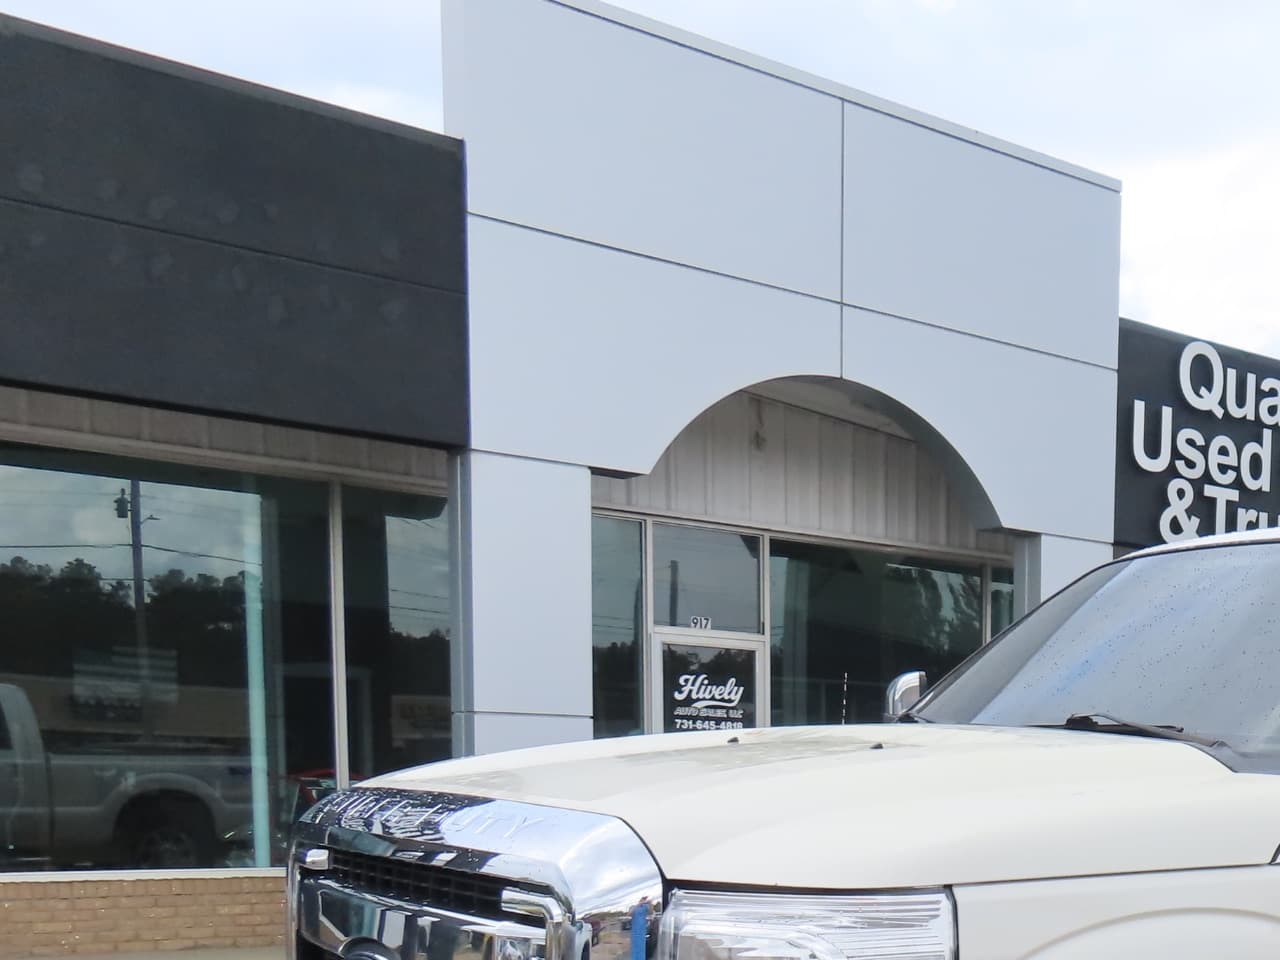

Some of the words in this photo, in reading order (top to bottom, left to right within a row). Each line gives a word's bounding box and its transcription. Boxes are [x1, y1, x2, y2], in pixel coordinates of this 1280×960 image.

[1133, 400, 1273, 492] Used
[691, 616, 709, 629] 917
[674, 674, 744, 708] Hively
[675, 719, 744, 730] 731-645-4818
